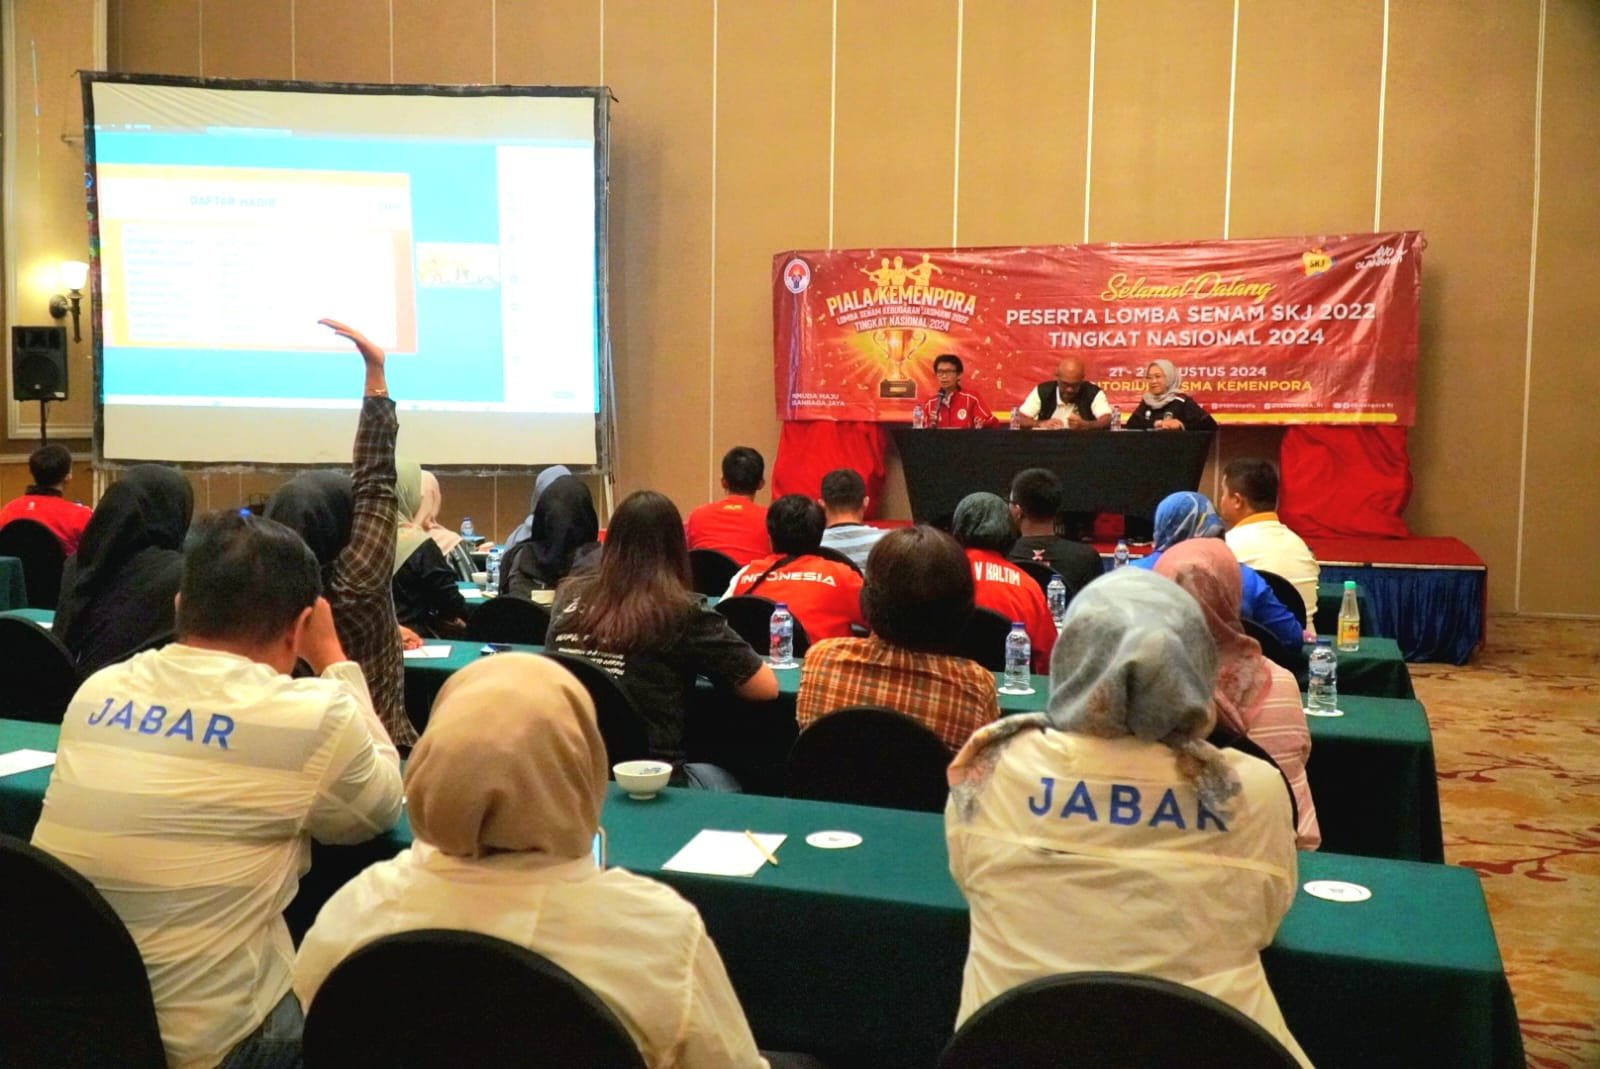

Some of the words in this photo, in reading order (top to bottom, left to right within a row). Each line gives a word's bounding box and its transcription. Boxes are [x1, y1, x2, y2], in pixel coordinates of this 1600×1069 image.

[1101, 273, 1186, 301] Selamat
[1190, 272, 1275, 303] Datang
[826, 288, 874, 317] PIALA
[879, 285, 977, 316] KEMENPORA
[855, 316, 887, 331] TINGKAT
[890, 315, 927, 327] NASIONAL
[929, 319, 950, 332] 2024
[1007, 309, 1097, 325] PESERTA
[1104, 307, 1180, 325] LOMBA
[1187, 305, 1264, 323] SENAM
[1271, 304, 1313, 322] SKJ
[1319, 303, 1376, 321] 2022
[1049, 331, 1140, 347] TINGKAT
[1147, 329, 1262, 346] NASIONAL
[1269, 328, 1325, 345] 2024
[1229, 367, 1268, 377] 2024
[1217, 381, 1313, 392] KEMENPORA
[985, 561, 1021, 587] KALTIM
[87, 698, 235, 749] JABAR
